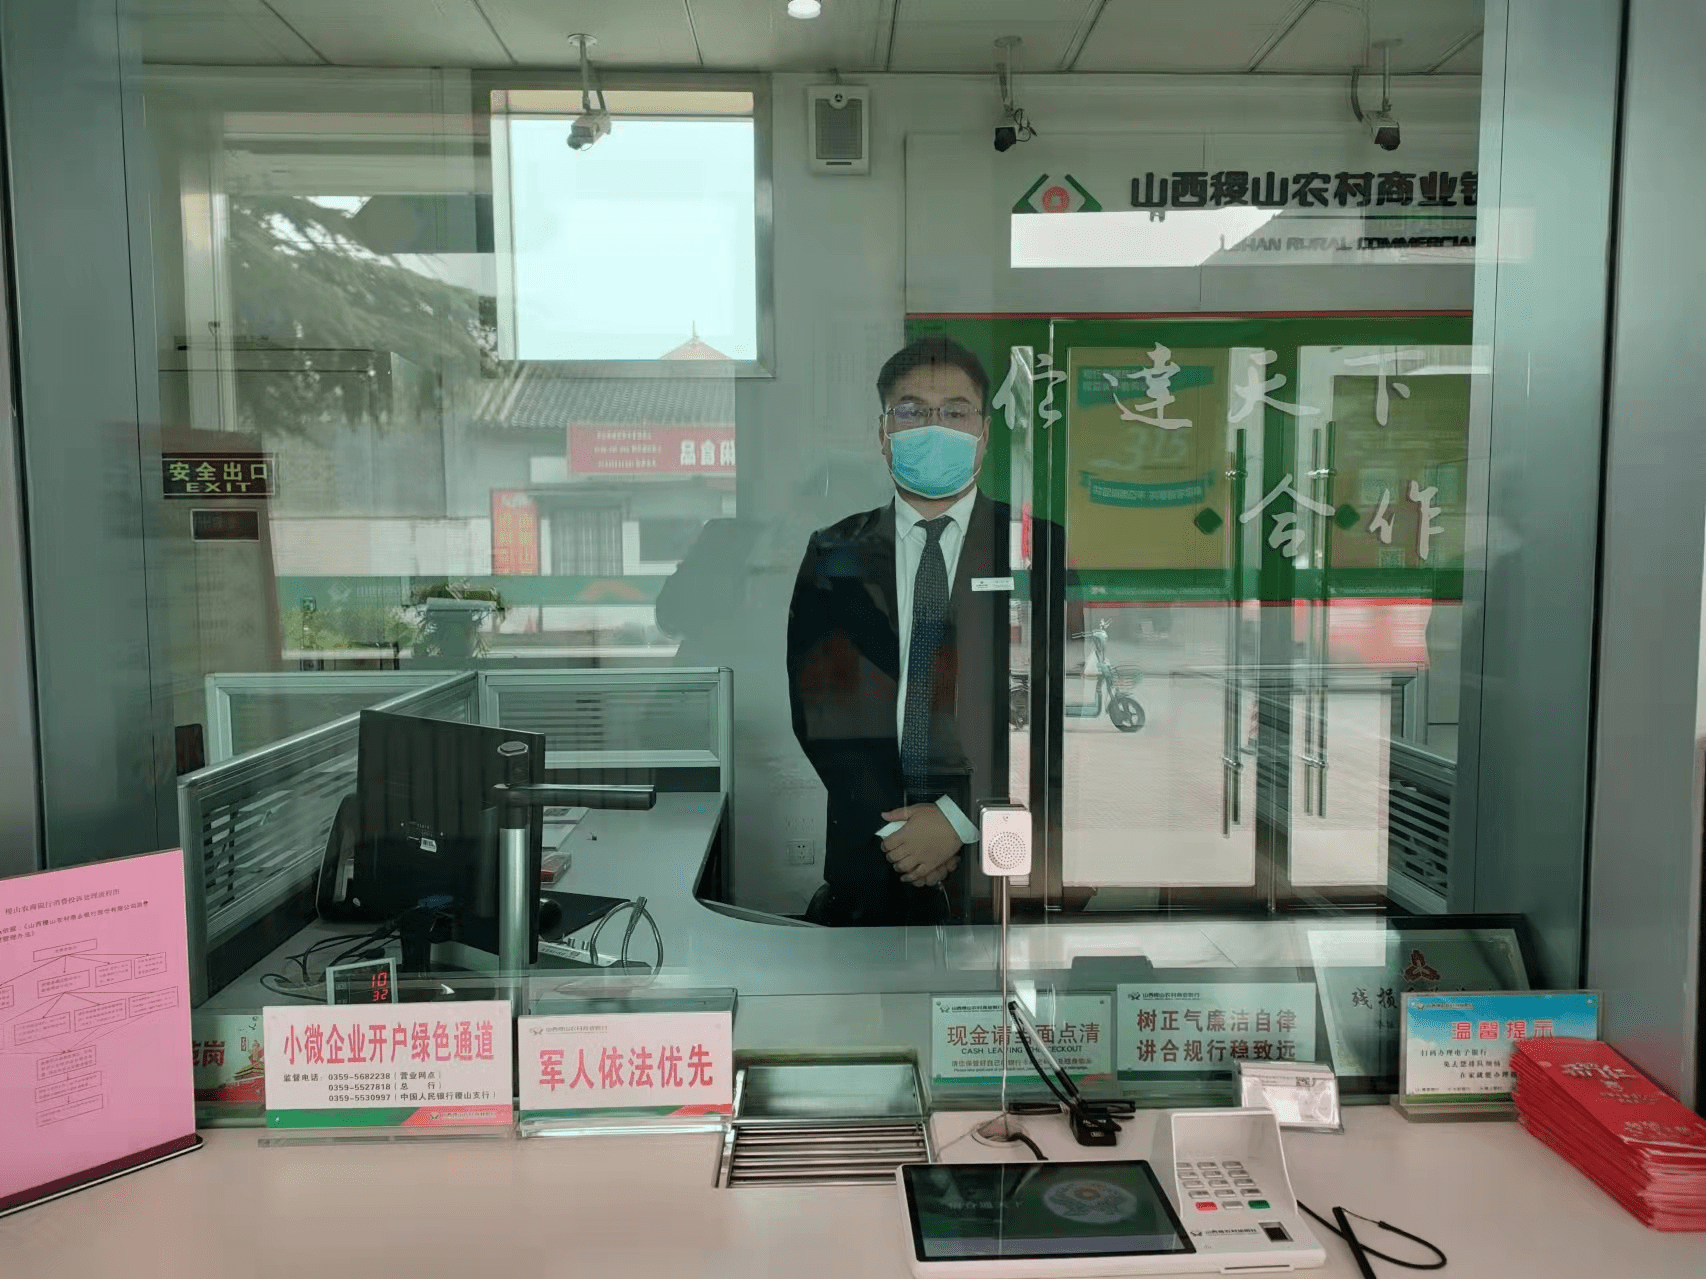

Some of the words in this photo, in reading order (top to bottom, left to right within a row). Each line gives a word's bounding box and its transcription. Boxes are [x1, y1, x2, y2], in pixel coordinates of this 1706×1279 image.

[169, 462, 268, 481] 安全出口
[186, 482, 251, 492] EXIT
[372, 971, 388, 988] 10
[373, 988, 389, 1002] 32
[1137, 1009, 1297, 1032] 树正气廉洁自律
[1451, 1021, 1554, 1040] 温馨提示
[283, 1020, 494, 1066] 小微企业开户绿色通道
[988, 1046, 1022, 1054] LEAING
[1048, 1045, 1083, 1053] ECKOUT
[1136, 1039, 1296, 1063] 讲合规行稳致远
[539, 1044, 713, 1092] 军人依法优先
[328, 1073, 391, 1081] 0359-5682238
[328, 1083, 391, 1091] 0359-5527818
[328, 1094, 391, 1102] 0359-5530997
